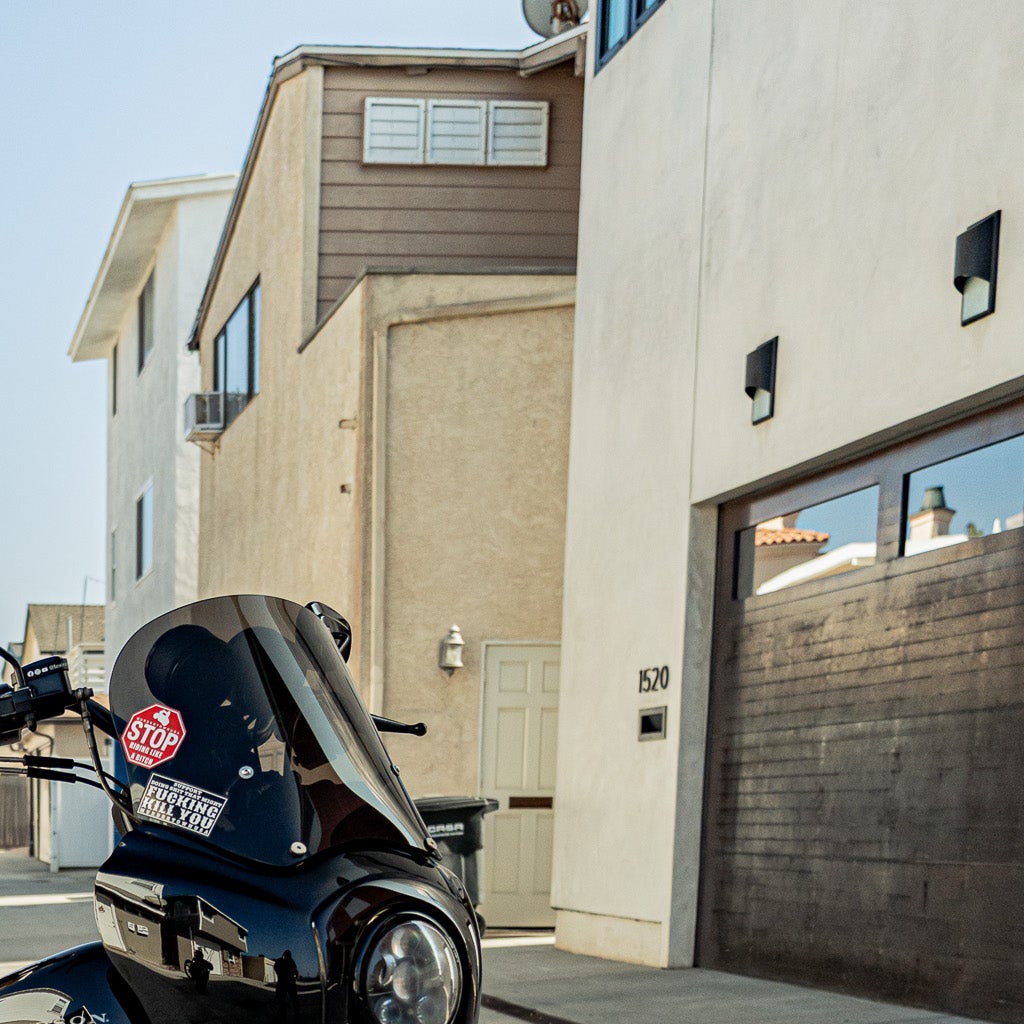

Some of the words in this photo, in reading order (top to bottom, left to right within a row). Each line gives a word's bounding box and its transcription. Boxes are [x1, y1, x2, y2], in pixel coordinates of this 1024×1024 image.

[638, 665, 670, 694] 1520
[127, 720, 179, 751] STOP
[129, 741, 151, 755] RIDING
[149, 748, 164, 759] LIKE
[130, 752, 136, 760] A
[135, 753, 154, 766] BITCH
[147, 785, 219, 819] FUCKING
[151, 780, 169, 790] DOING
[170, 785, 183, 795] SHIT
[184, 791, 202, 801] THAT
[201, 796, 223, 808] MIGHT
[173, 782, 203, 795] SUPPORT
[142, 796, 175, 817] KILL
[179, 807, 215, 829] YOU
